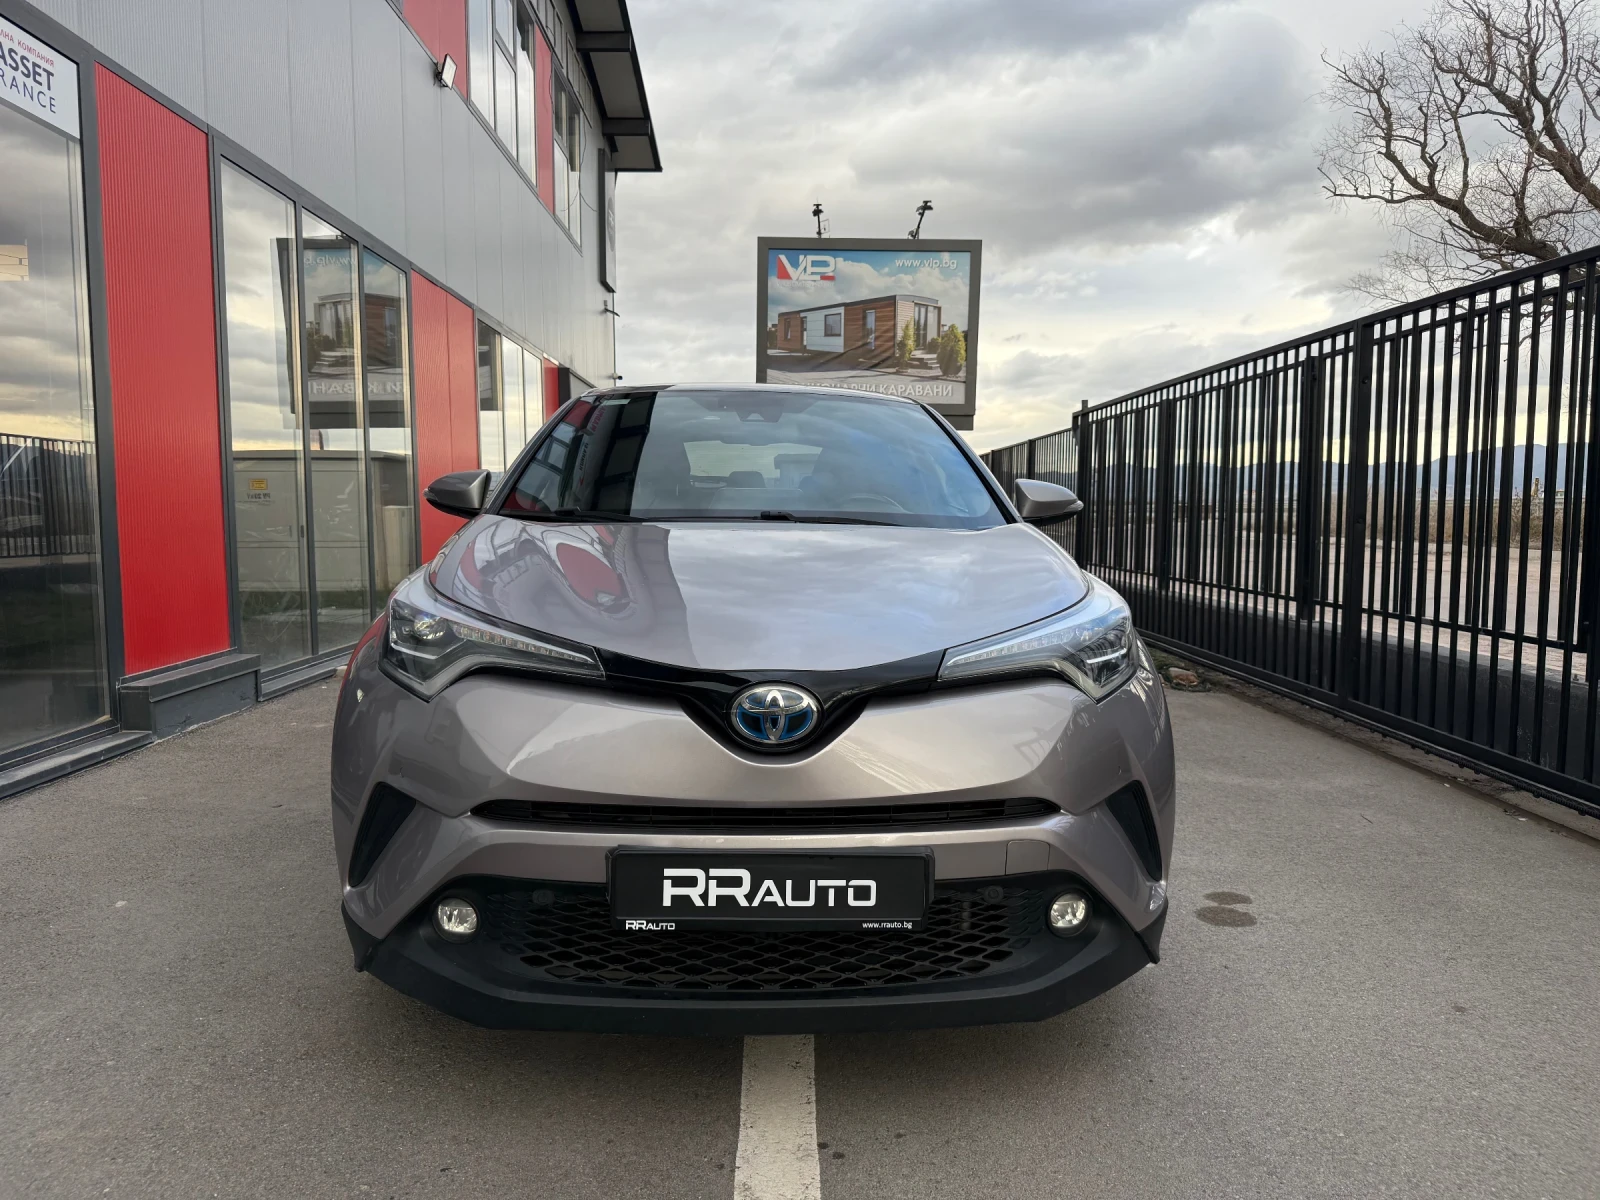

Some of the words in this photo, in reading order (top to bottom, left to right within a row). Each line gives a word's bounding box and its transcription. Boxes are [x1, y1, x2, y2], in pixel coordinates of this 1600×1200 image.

[17, 39, 54, 68] КОМПАНИЯ
[0, 42, 54, 91] ASSET
[0, 67, 56, 114] RANCE
[895, 258, 957, 269] www.vlp.bg
[879, 384, 953, 396] КАРАВАНИ
[662, 868, 877, 907] RRAUTO
[626, 920, 676, 930] RRAUTO
[862, 921, 912, 930] www.rrauto.bg
